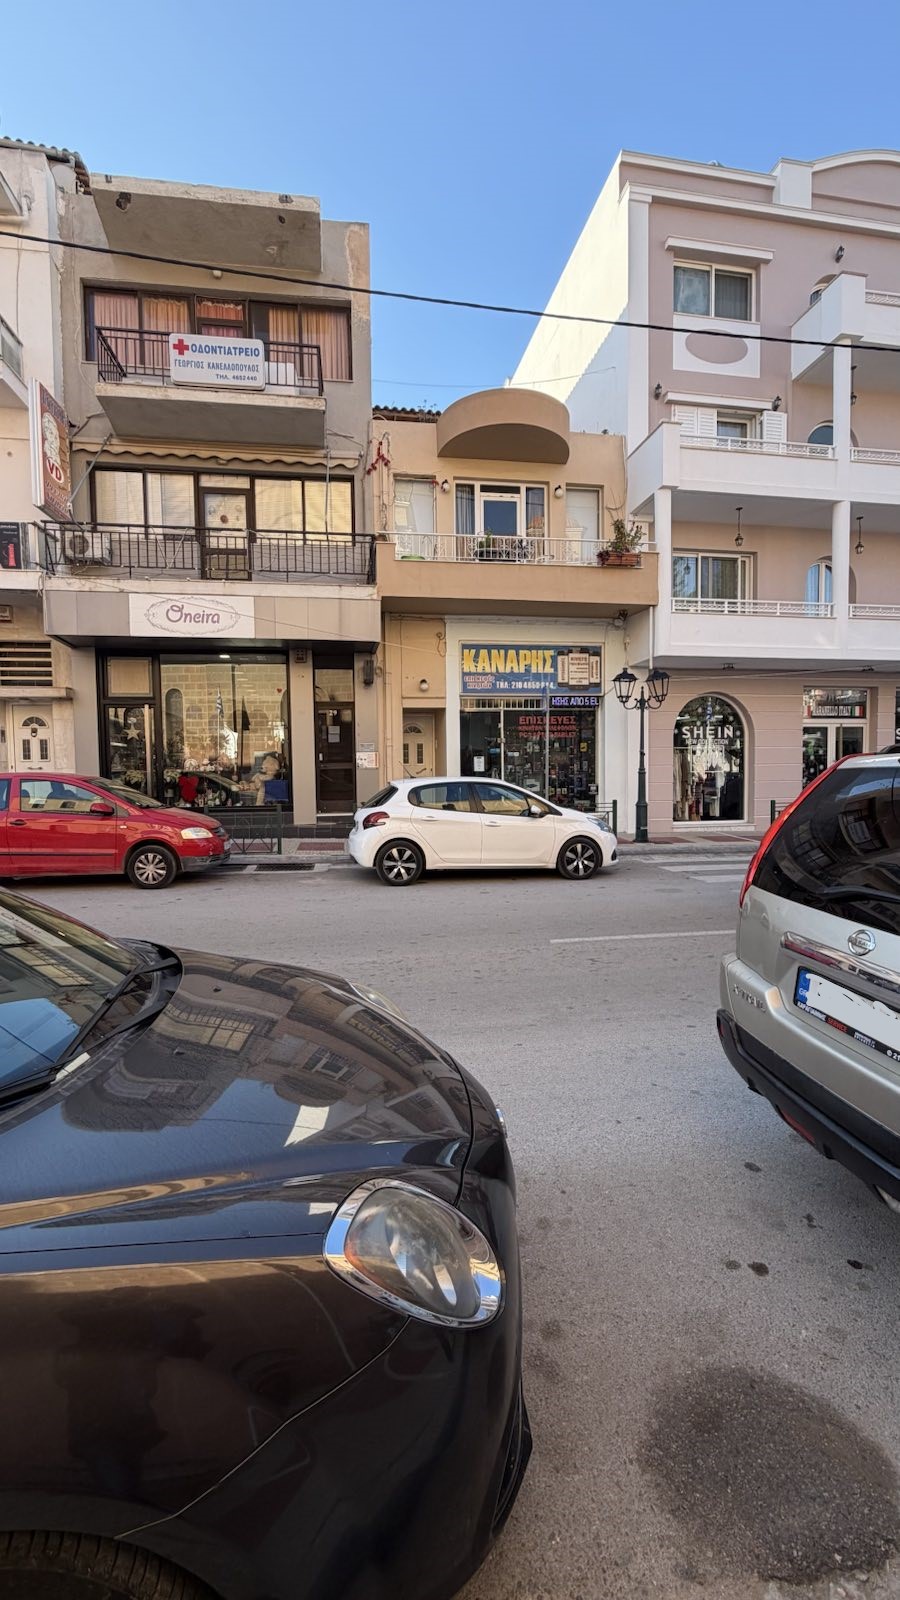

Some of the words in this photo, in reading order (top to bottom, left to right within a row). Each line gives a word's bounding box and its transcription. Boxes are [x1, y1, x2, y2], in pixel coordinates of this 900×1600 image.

[190, 343, 260, 358] ΟΔΟΝΤΙΑΤΡΕΙΟ
[174, 358, 205, 369] ΓΕΩΡΓΙΟΣ
[165, 604, 221, 624] Oneira
[463, 649, 555, 673] ΚΑΝΑΡΗΣ
[682, 725, 734, 739] SHEIN
